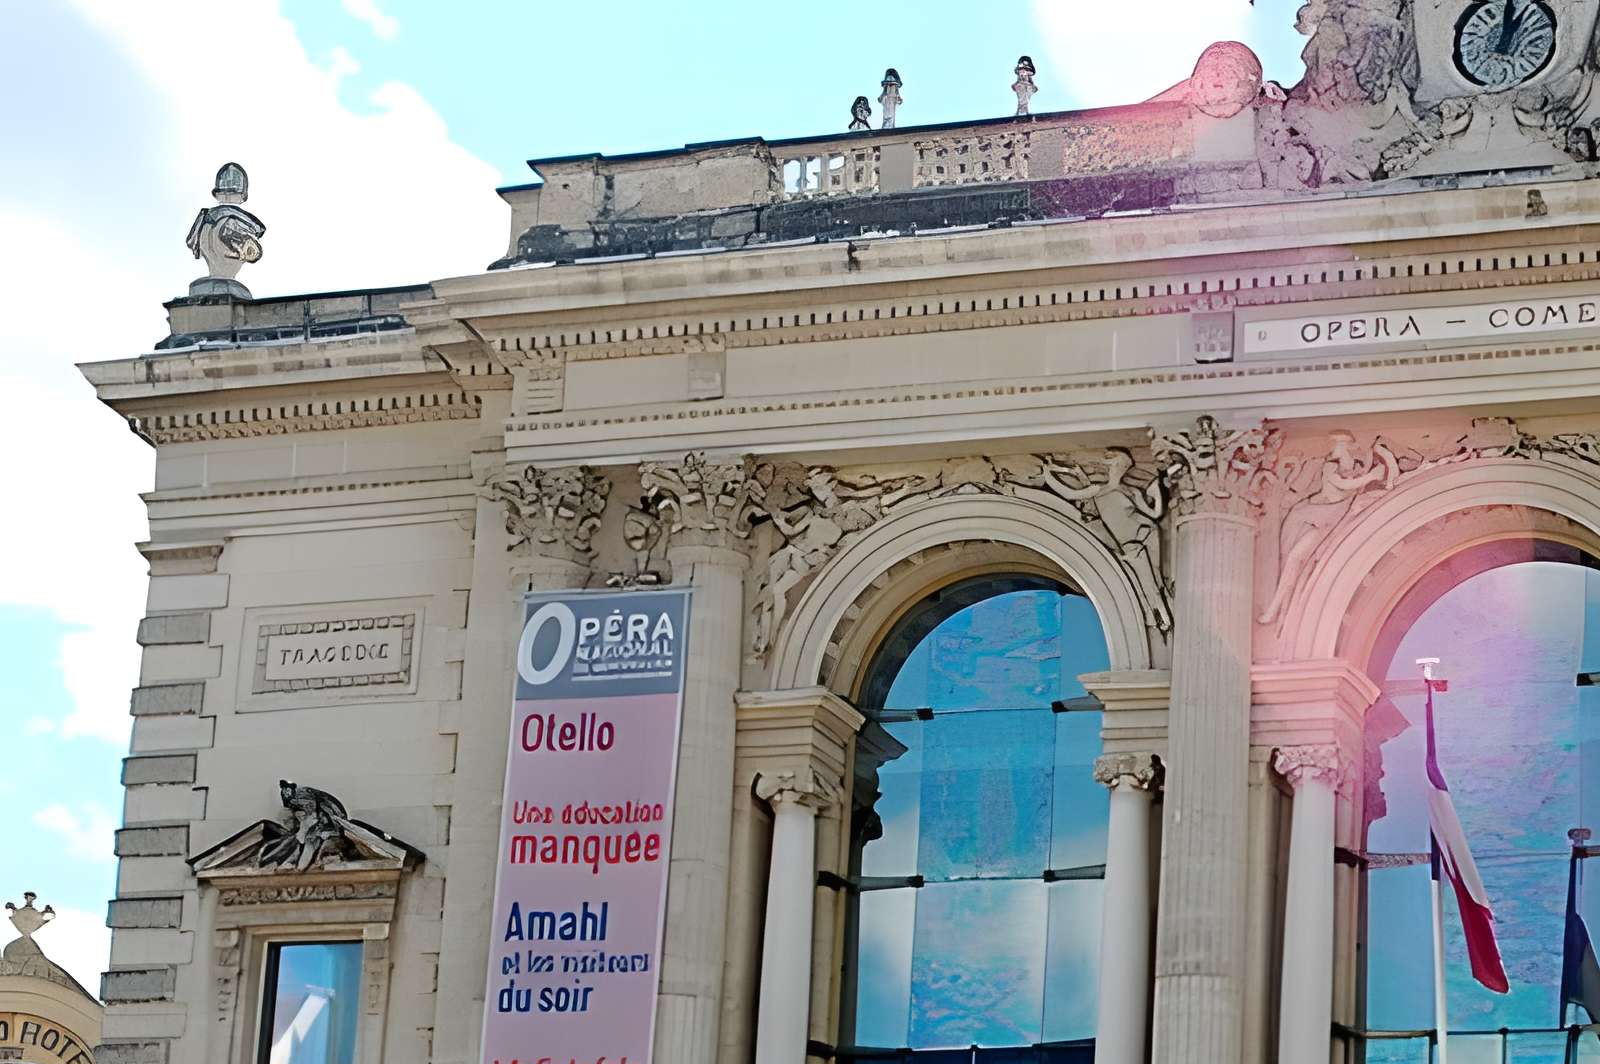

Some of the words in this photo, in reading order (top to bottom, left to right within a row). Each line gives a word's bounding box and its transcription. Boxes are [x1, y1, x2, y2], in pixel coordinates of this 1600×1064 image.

[1301, 316, 1422, 344] OPERA
[517, 602, 674, 685] OPÉRA
[522, 712, 615, 752] Otello
[510, 829, 661, 875] manquée
[504, 901, 609, 942] Amahl
[498, 979, 532, 1013] du
[537, 978, 594, 1013] soir
